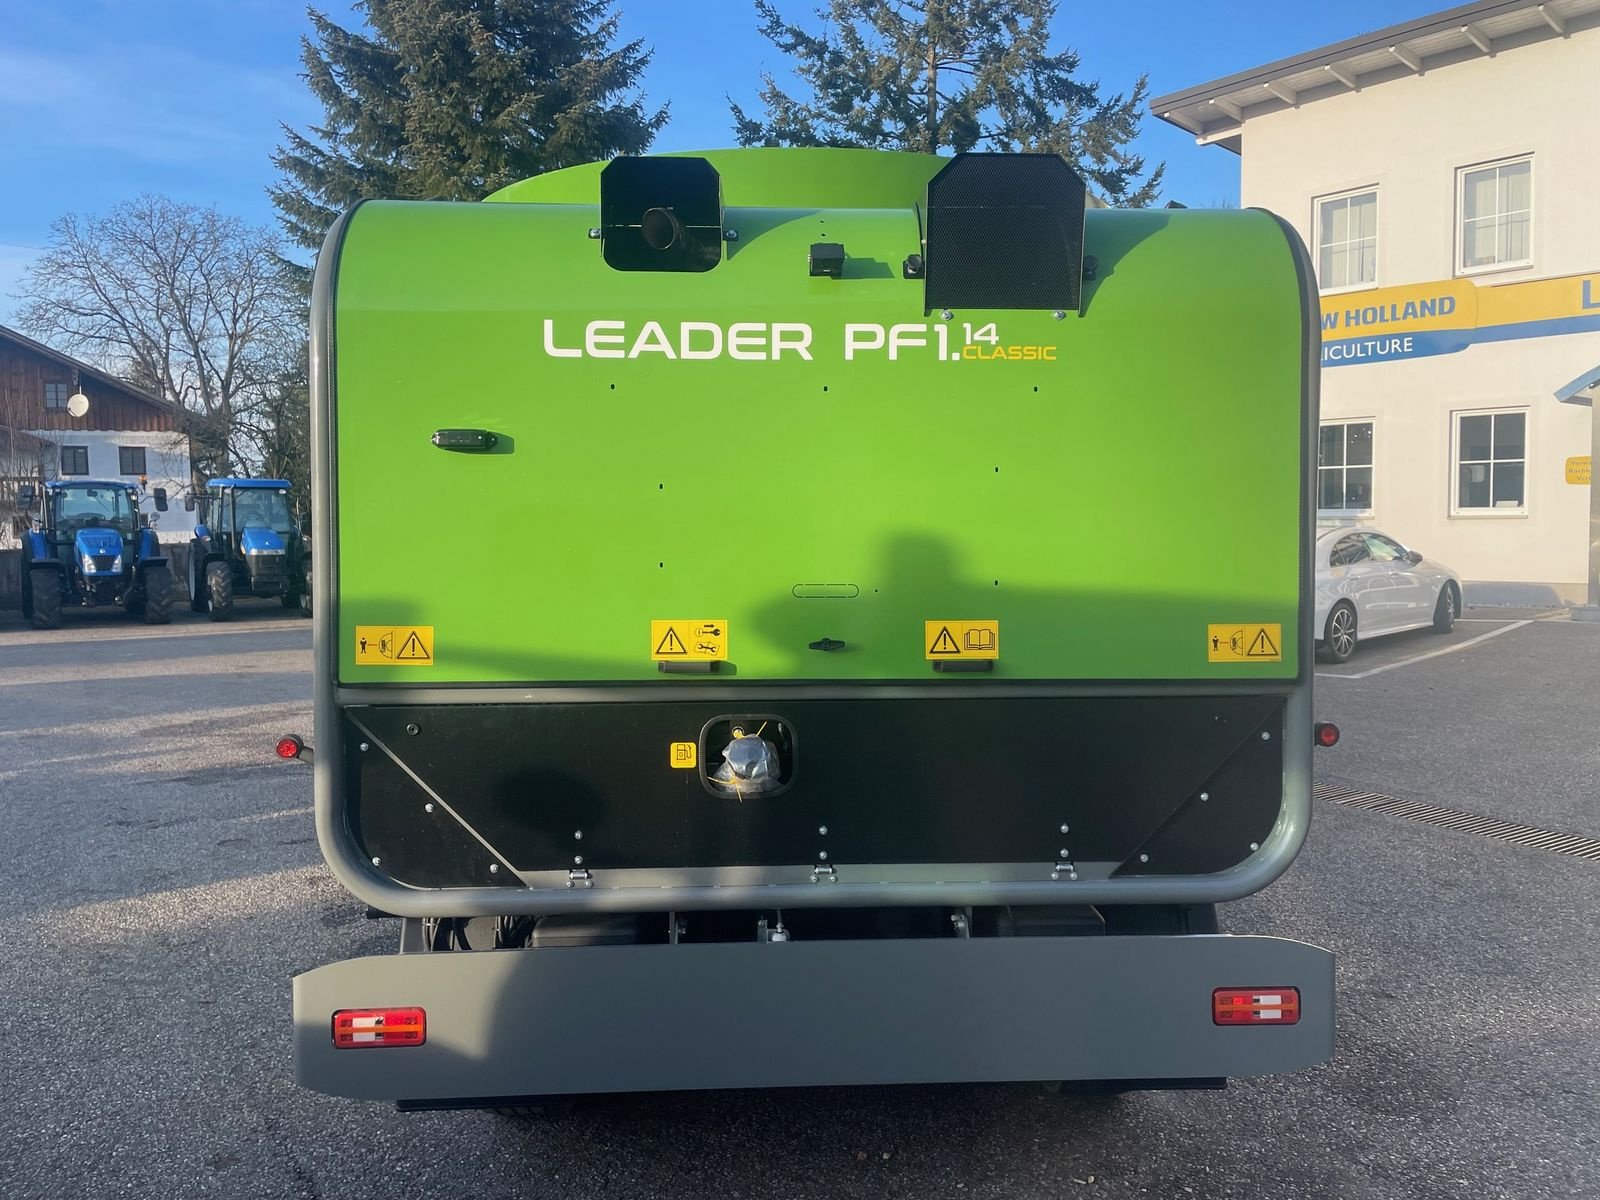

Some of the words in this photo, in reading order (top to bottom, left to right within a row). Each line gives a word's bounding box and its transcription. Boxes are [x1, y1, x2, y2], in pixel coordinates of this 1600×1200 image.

[1344, 296, 1456, 328] HOLLAND
[543, 319, 814, 361] LEADER
[962, 346, 1057, 360] CLASSIC
[1321, 337, 1413, 361] ICULTURE
